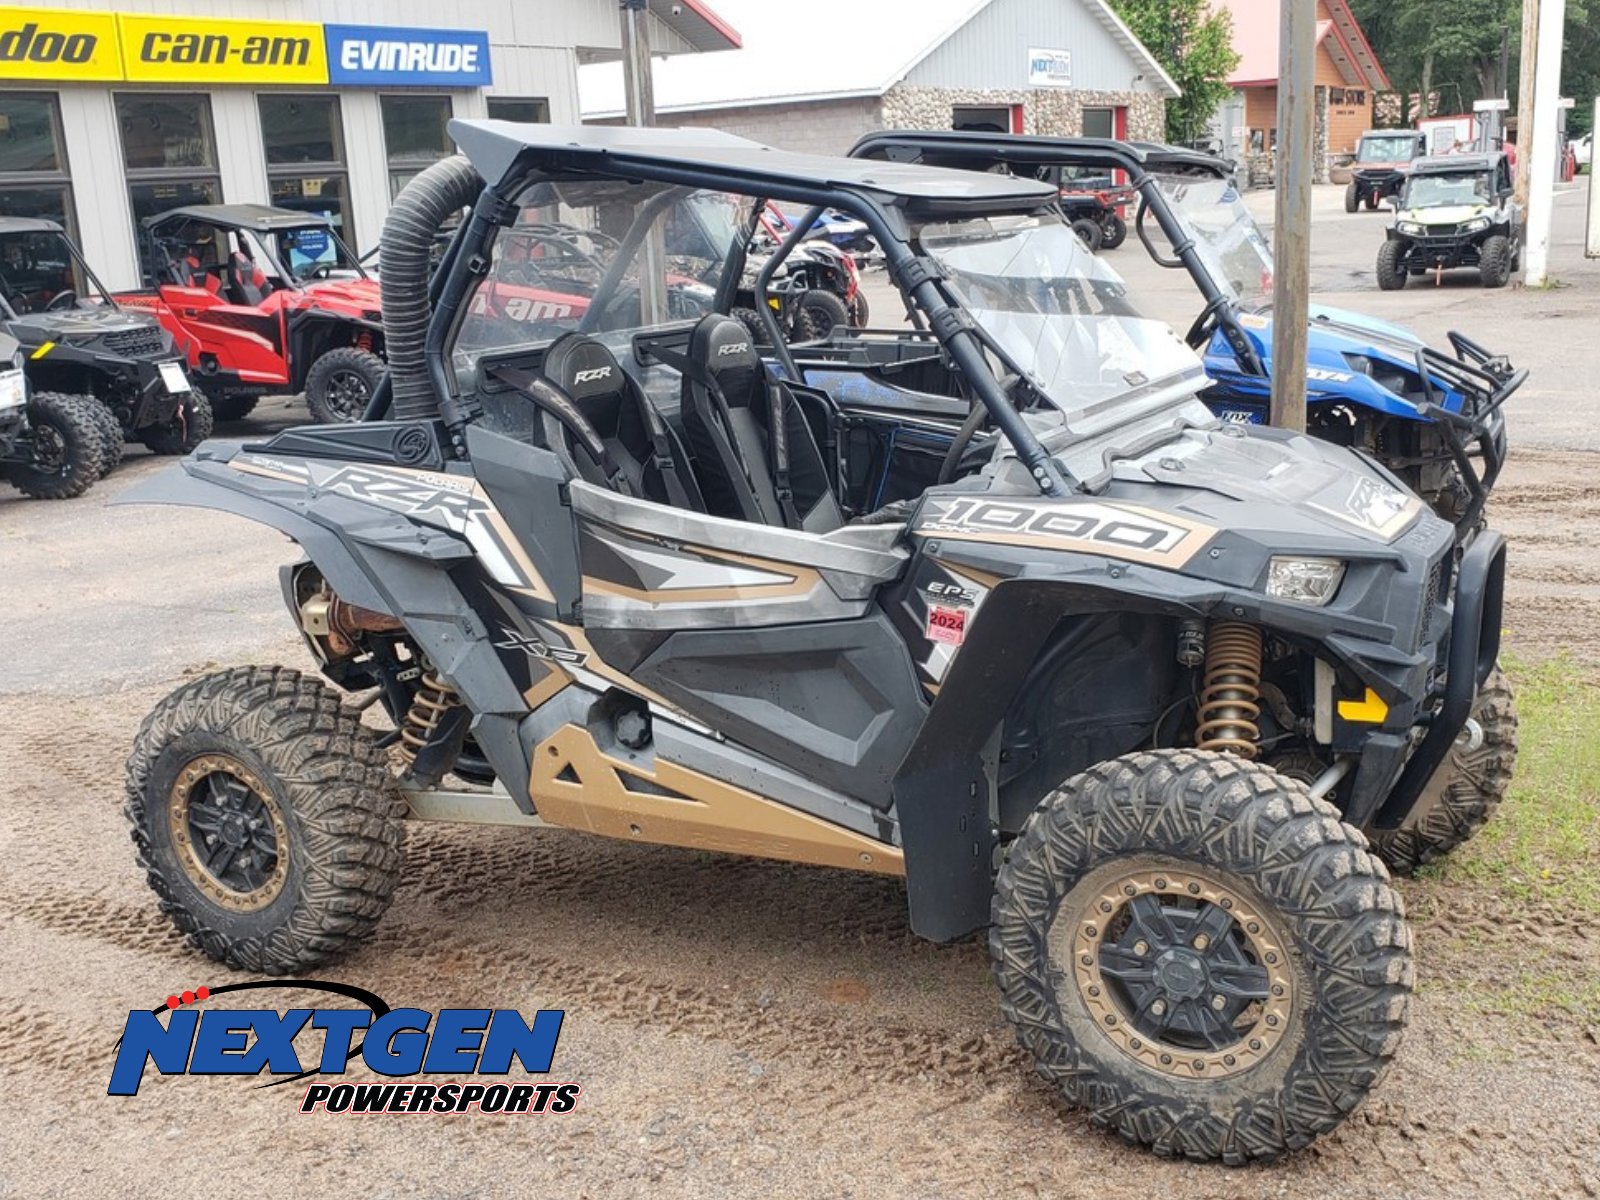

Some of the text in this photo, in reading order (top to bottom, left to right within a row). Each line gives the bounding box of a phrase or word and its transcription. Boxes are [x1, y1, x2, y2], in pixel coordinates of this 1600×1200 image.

[0, 23, 98, 63] doo
[140, 32, 311, 66] can-am
[341, 40, 479, 72] EVINRUDE
[718, 343, 748, 356] RZR
[574, 366, 612, 385] RZR
[322, 466, 493, 526] RZR
[416, 473, 471, 493] POLARIS
[943, 498, 1169, 549] 1000
[928, 581, 979, 600] EPS
[930, 612, 964, 632] 2024
